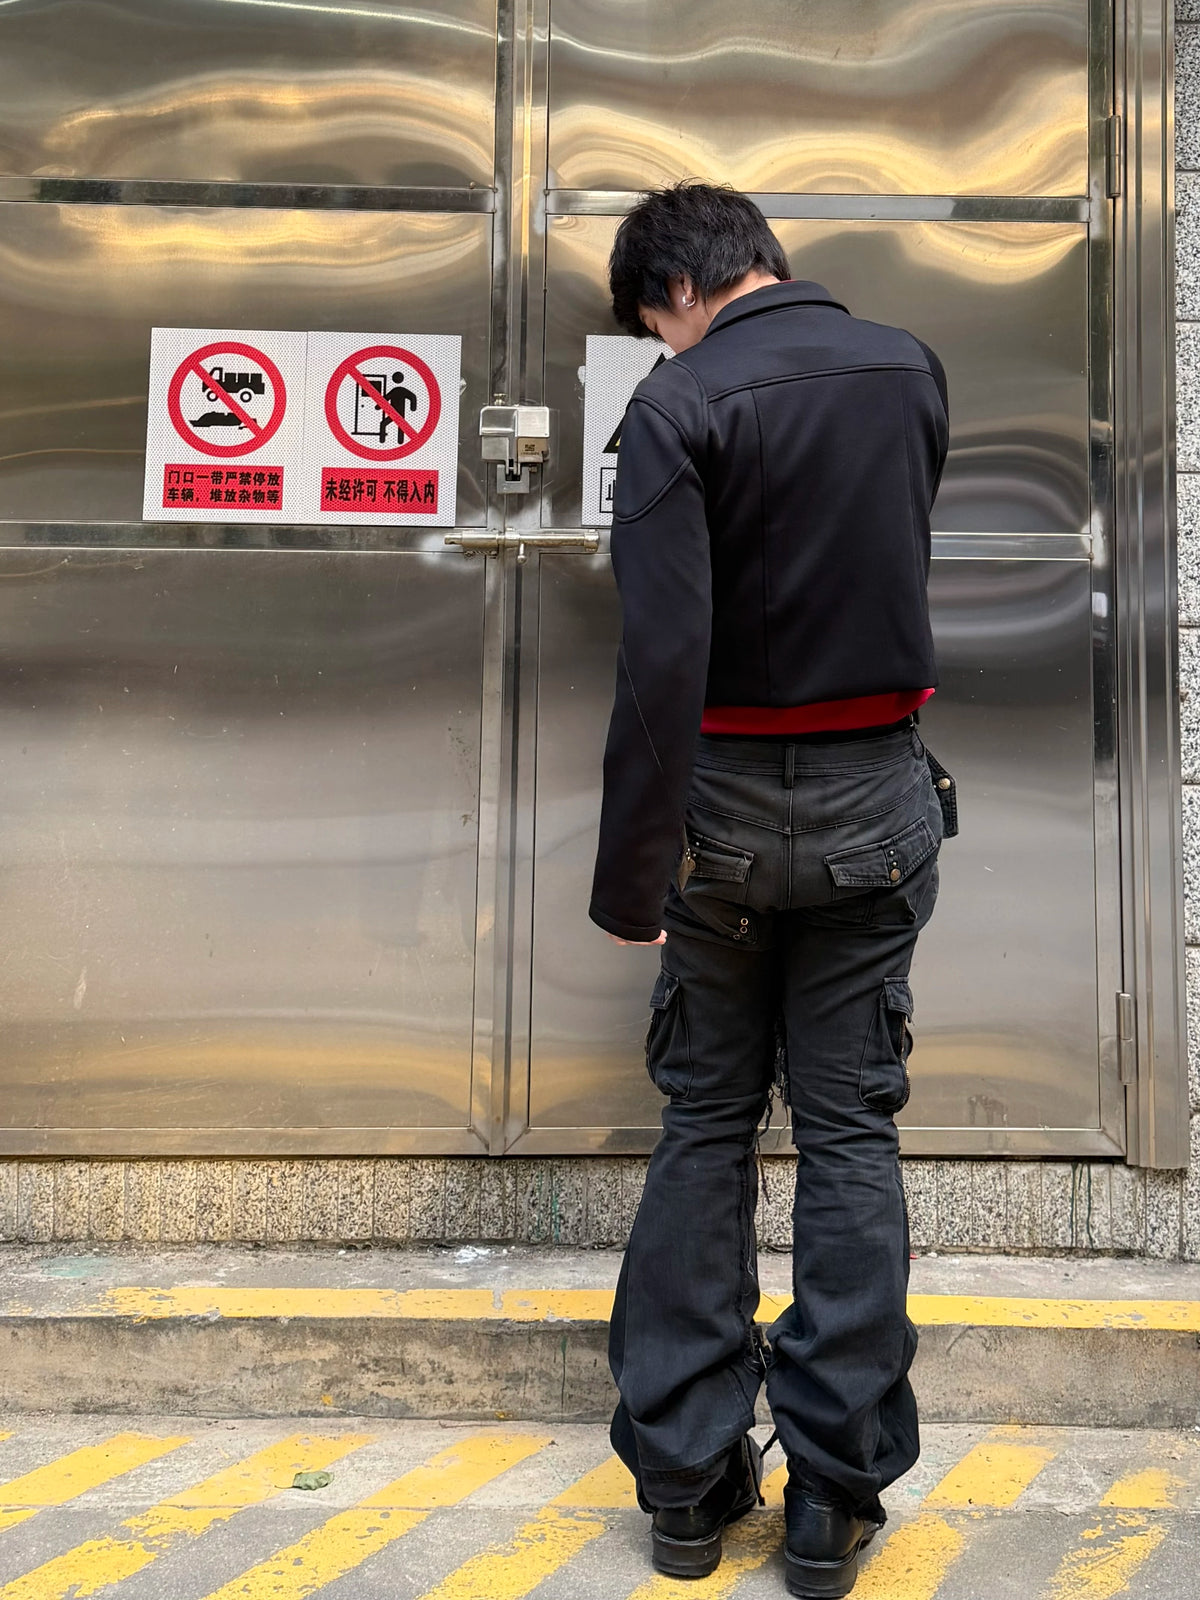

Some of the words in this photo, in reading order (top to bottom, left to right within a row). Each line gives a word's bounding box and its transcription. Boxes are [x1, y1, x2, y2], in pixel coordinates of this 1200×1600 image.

[168, 470, 280, 486] 门口一带严禁停放
[325, 477, 378, 502] 未经许可
[383, 479, 435, 503] 不得入内
